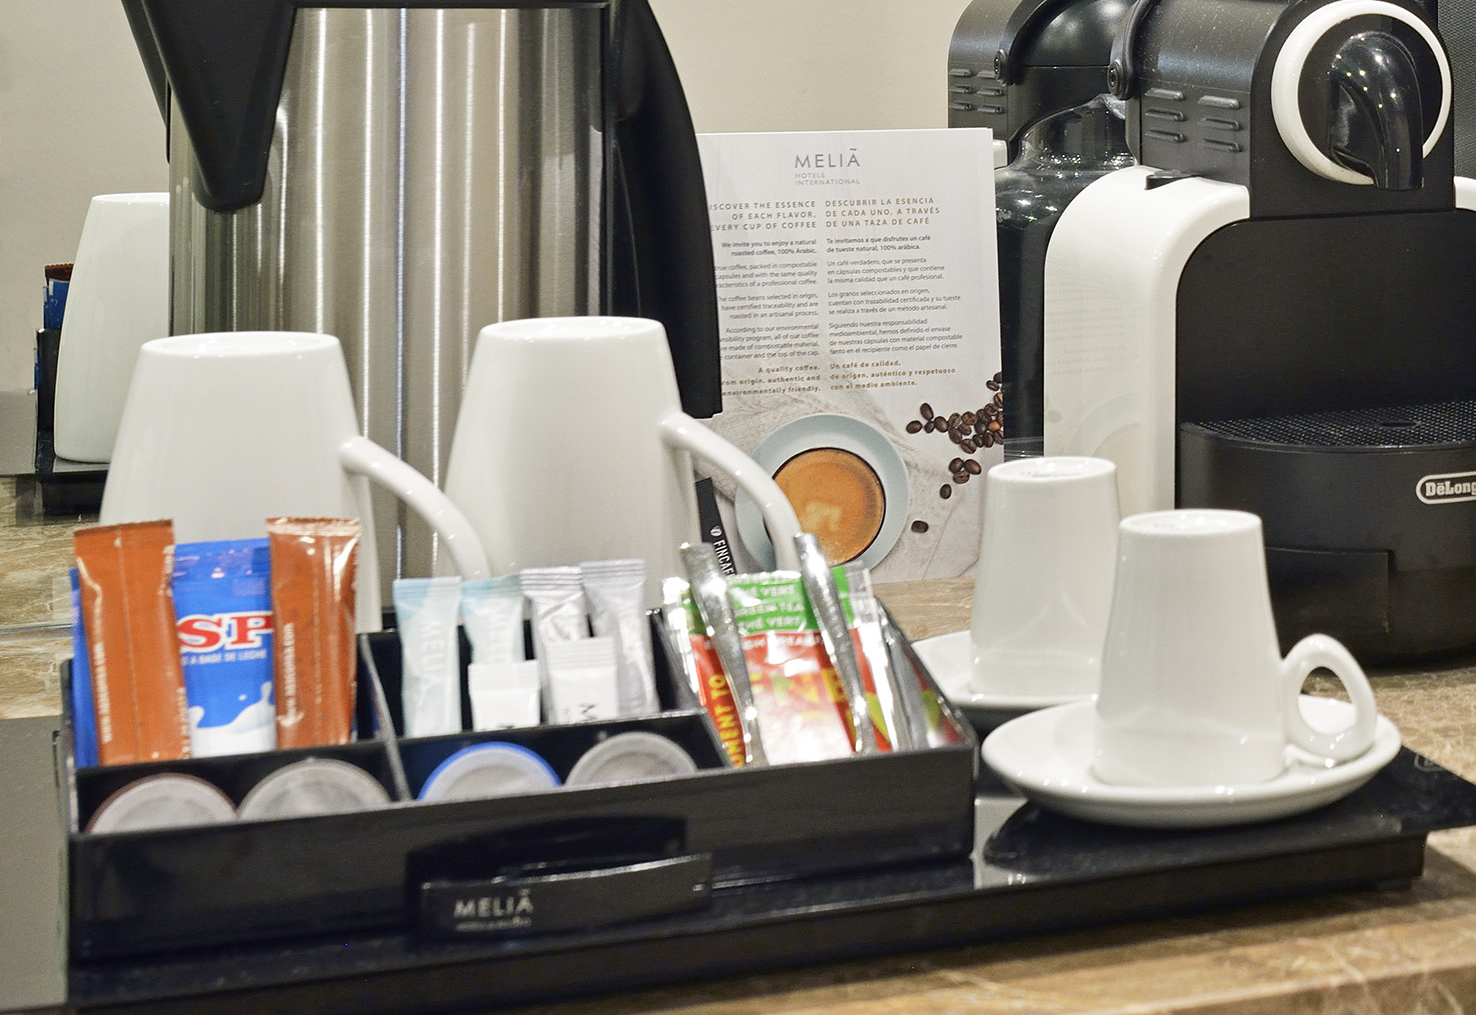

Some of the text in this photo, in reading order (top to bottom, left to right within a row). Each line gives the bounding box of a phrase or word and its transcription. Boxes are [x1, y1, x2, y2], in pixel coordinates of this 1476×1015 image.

[907, 217, 930, 225] CAFÉ
[871, 370, 906, 378] auténtico
[915, 368, 956, 376] respetuoso
